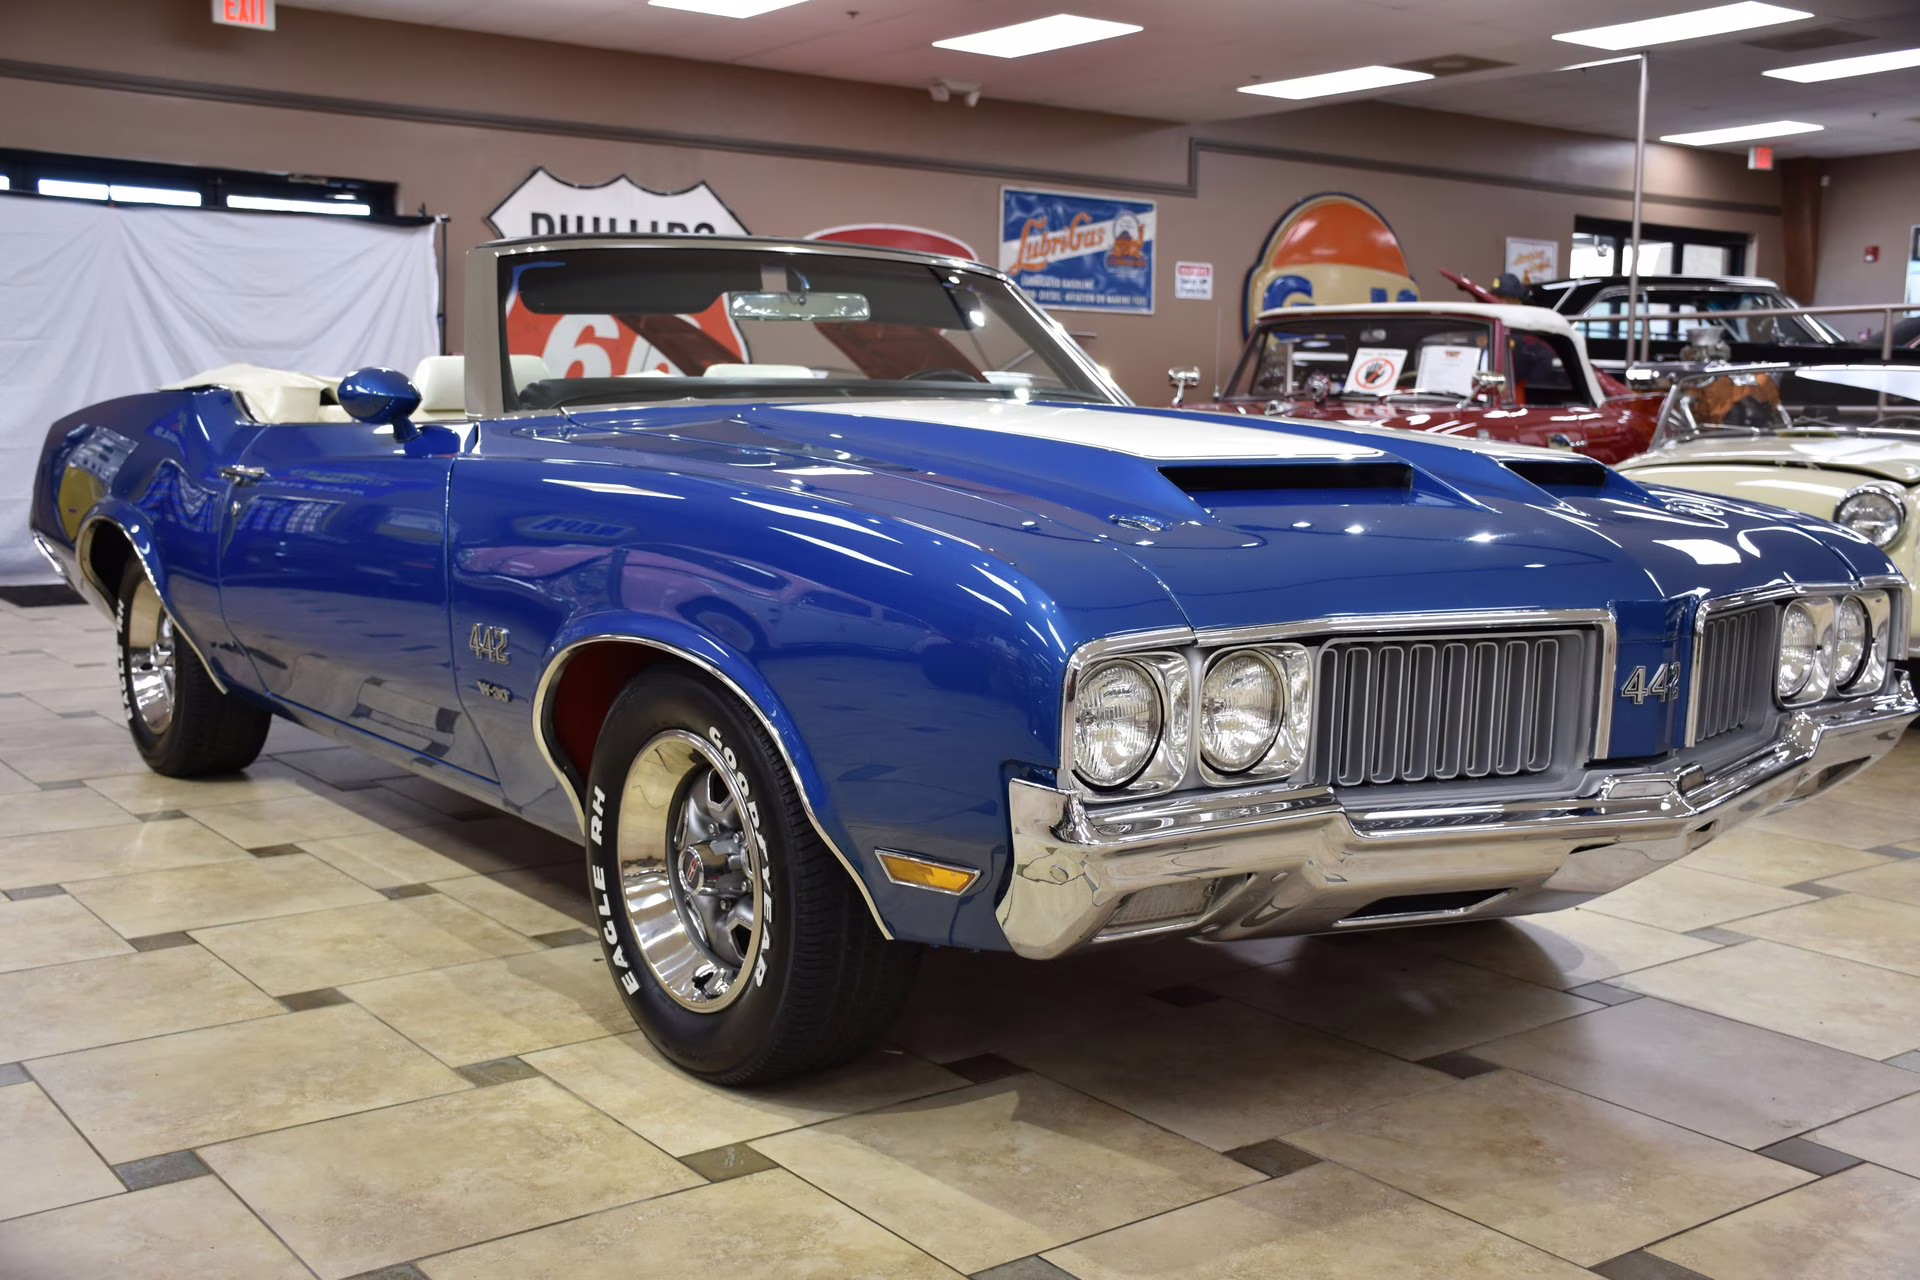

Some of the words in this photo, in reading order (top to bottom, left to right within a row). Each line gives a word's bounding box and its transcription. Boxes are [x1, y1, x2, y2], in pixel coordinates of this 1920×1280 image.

[470, 623, 511, 665] 442
[1621, 661, 1681, 704] 442
[591, 785, 606, 846] RH
[592, 864, 640, 996] EAGLE
